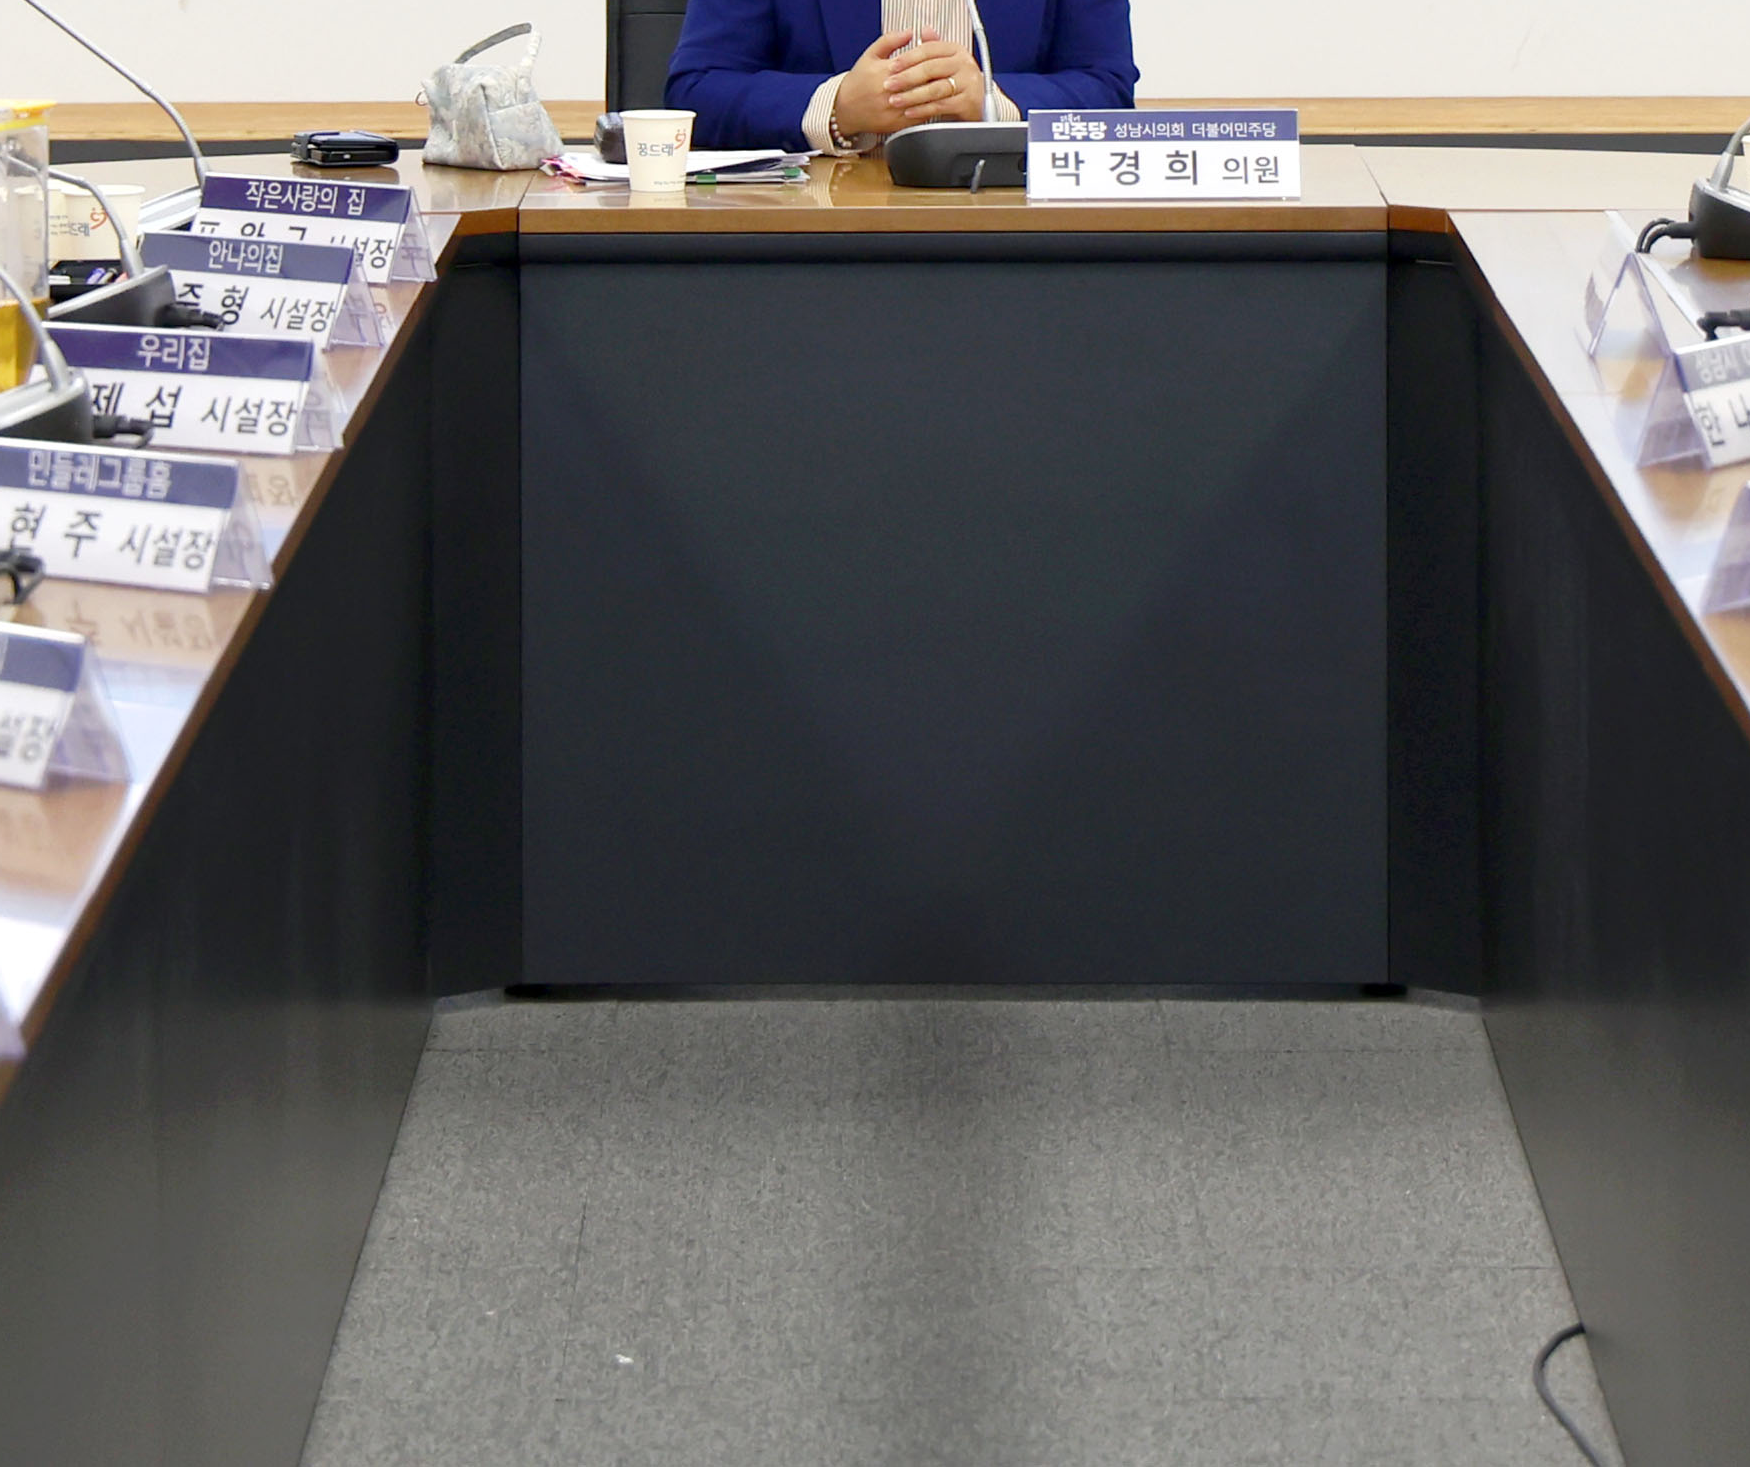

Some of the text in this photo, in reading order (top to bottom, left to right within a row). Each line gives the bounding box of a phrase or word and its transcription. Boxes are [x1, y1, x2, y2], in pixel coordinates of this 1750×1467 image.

[1051, 121, 1277, 140] 민주당 성남시의회 더불어민주당
[1222, 155, 1280, 186] 의원
[245, 182, 367, 217] 작은사랑의 집
[208, 239, 284, 274] 안나의집
[259, 296, 337, 333] 시설장
[137, 334, 212, 372] 우리집
[201, 396, 298, 438] 시설장
[27, 450, 172, 500] 민들레그룹홈
[118, 523, 215, 571] 시설장
